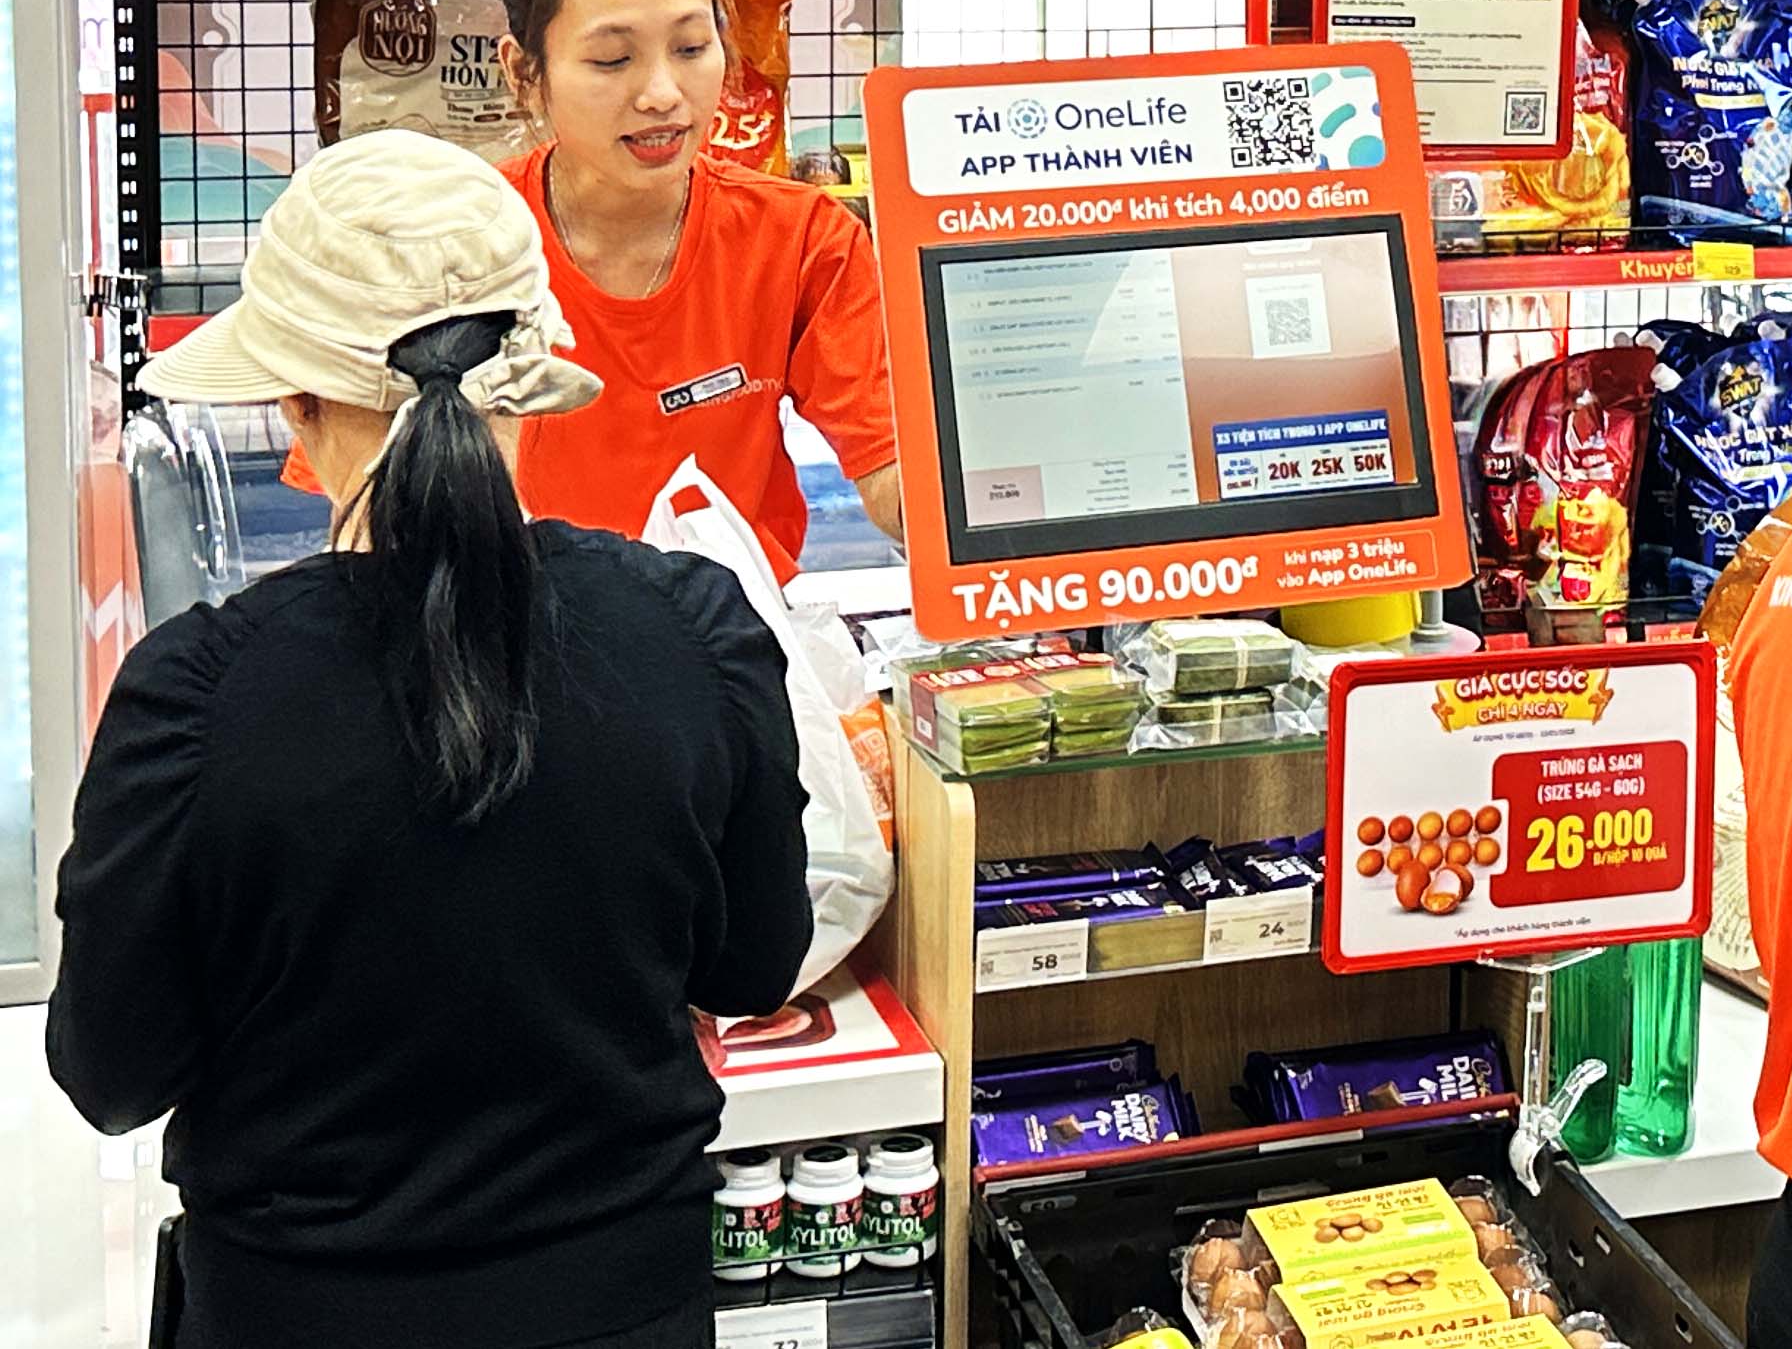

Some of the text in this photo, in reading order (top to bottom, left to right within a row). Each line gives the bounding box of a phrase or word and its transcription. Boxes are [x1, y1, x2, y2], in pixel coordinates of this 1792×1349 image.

[373, 9, 427, 36] HƯƠNG
[373, 34, 426, 66] NỘI
[441, 62, 487, 88] HÒN
[953, 96, 1187, 135] TẢI OneLife
[960, 139, 1194, 178] APP THÀNH VIÊN
[937, 180, 1370, 235] GIẢM 20.000đ khi tích 4,000 điểm
[1720, 376, 1765, 410] SWAT
[1323, 421, 1344, 436] APP
[1268, 461, 1302, 481] 20K
[1311, 457, 1345, 477] 25K
[1353, 453, 1387, 473] 50K
[951, 538, 1404, 629] TẶNG 90.000đ khi nạp 3 triệu
[1277, 559, 1417, 590] vào App OneLife
[1456, 665, 1589, 699] GIÁ CỰC SỐC
[1477, 699, 1568, 723] CHỈ NGÀY
[1541, 753, 1643, 778] TRỨNG GÀ SẠCH
[1537, 783, 1573, 804] (SIZE
[1526, 807, 1653, 872] 26.000
[1259, 920, 1285, 939] 24
[1031, 953, 1058, 971] 58
[1110, 1099, 1133, 1142] MILK
[1124, 1092, 1151, 1144] DAIRY
[790, 1222, 857, 1247] XYLITOL
